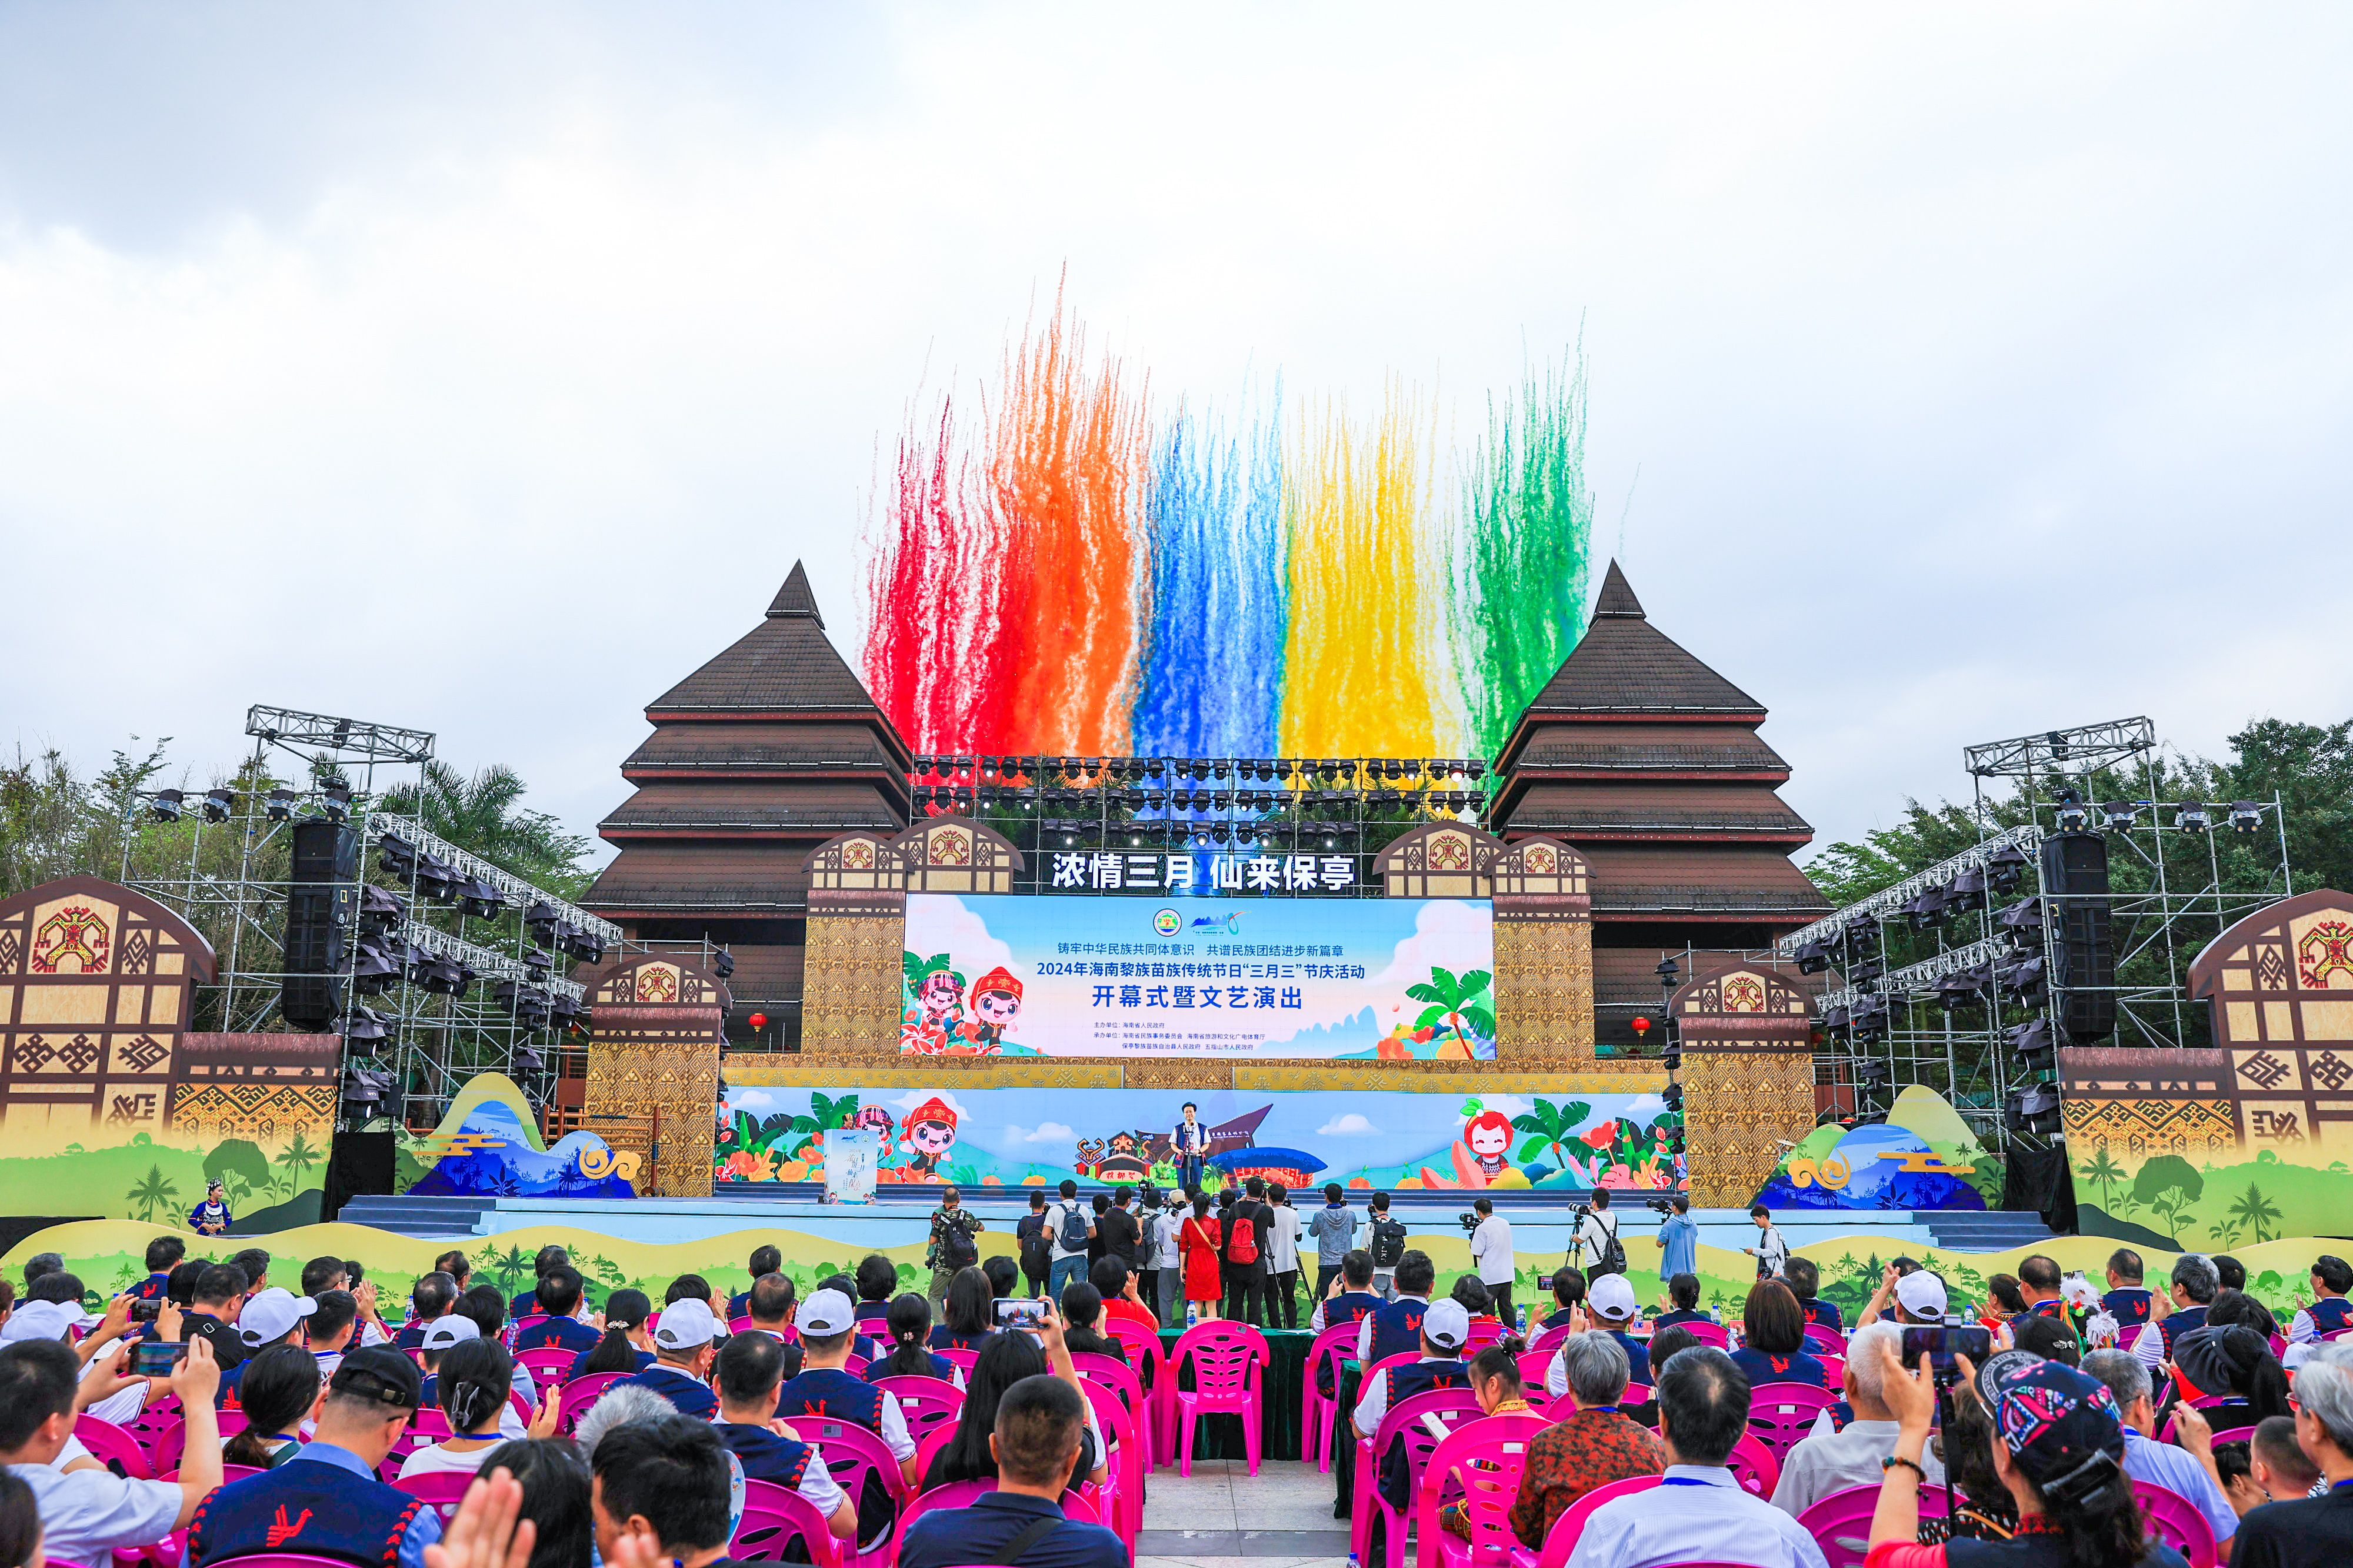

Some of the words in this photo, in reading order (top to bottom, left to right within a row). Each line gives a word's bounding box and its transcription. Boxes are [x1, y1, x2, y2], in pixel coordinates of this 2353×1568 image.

[1052, 852, 1192, 889] 浓情三月
[1210, 854, 1355, 891] 仙来保亭
[1058, 942, 1195, 956] 铸牢中华民族共同体意识
[1207, 943, 1344, 958] 共谱民族团结进步新篇章
[1092, 985, 1302, 1009] 开幕式暨文艺演出
